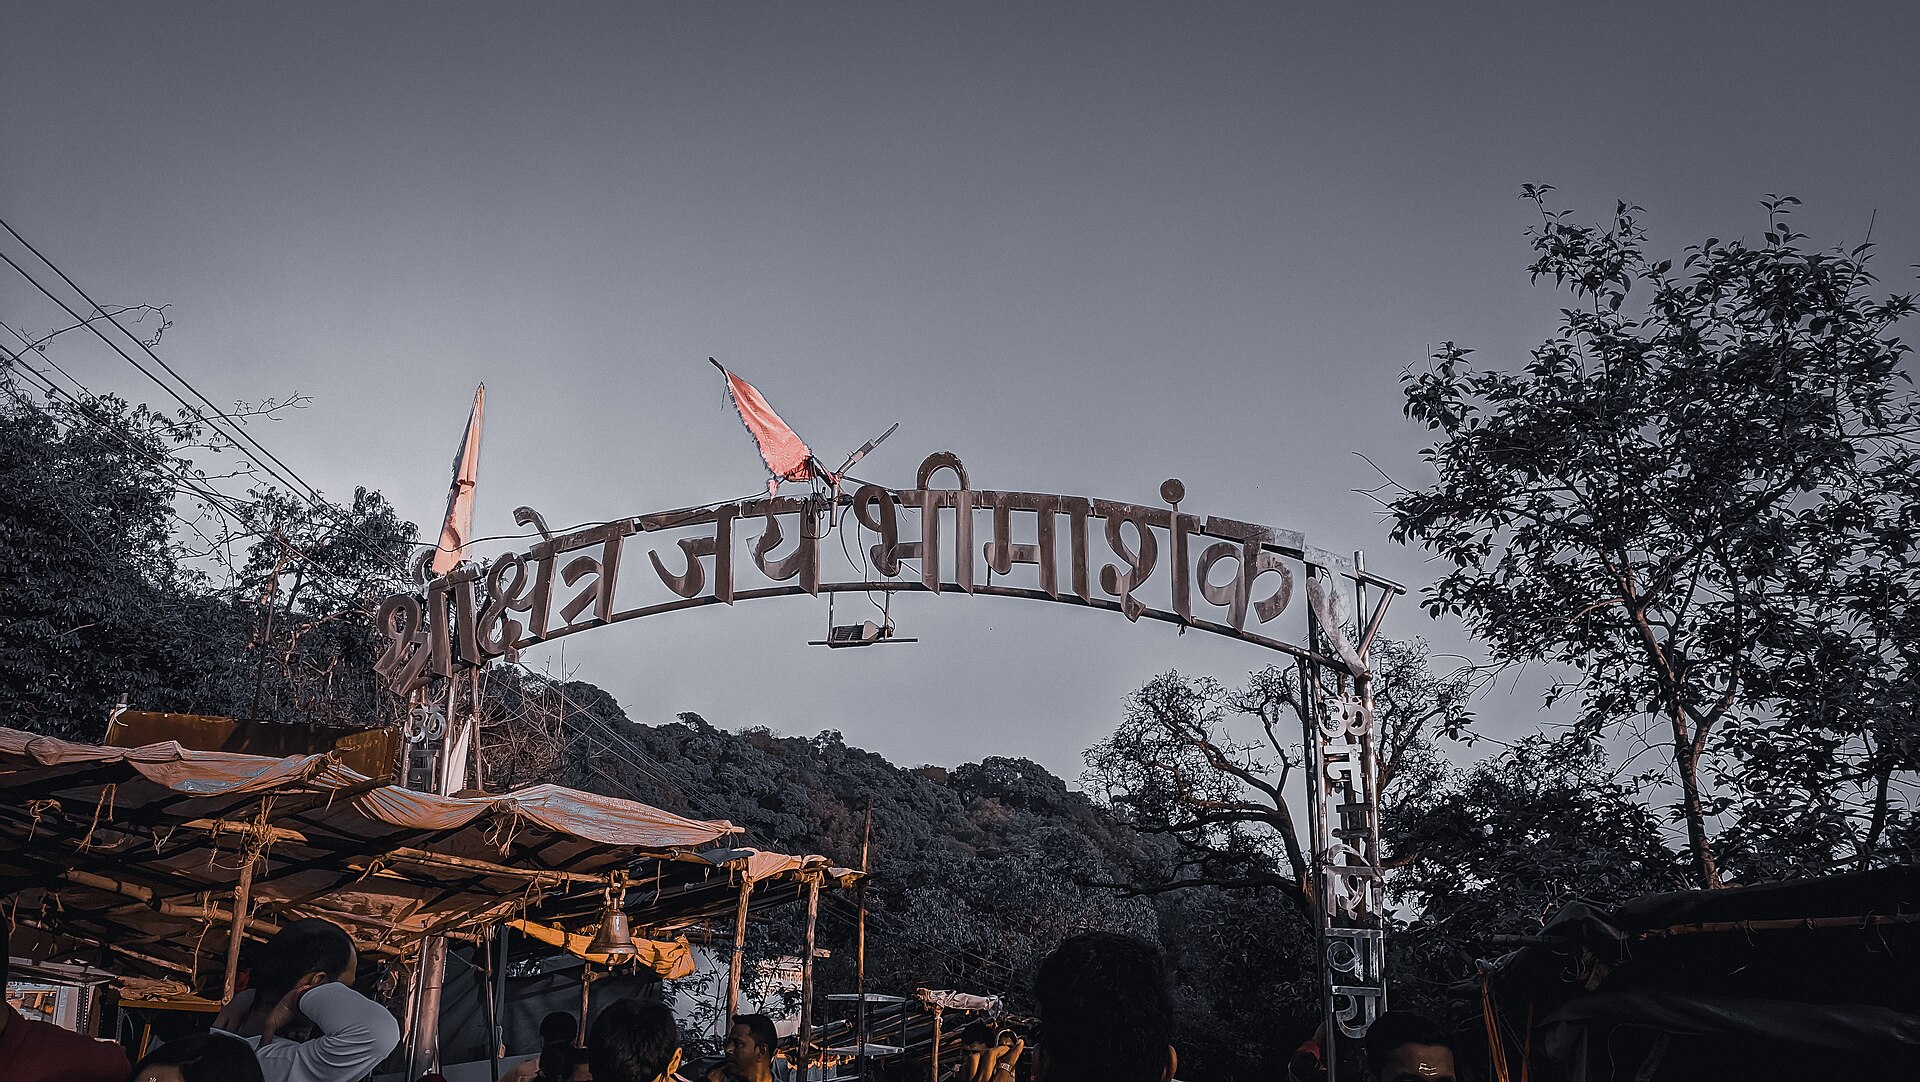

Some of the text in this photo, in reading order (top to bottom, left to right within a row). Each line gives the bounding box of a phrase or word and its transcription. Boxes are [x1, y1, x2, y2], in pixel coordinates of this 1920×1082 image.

[373, 546, 482, 696] श्री
[477, 506, 637, 664] क्षेत्र
[640, 497, 824, 606] जय
